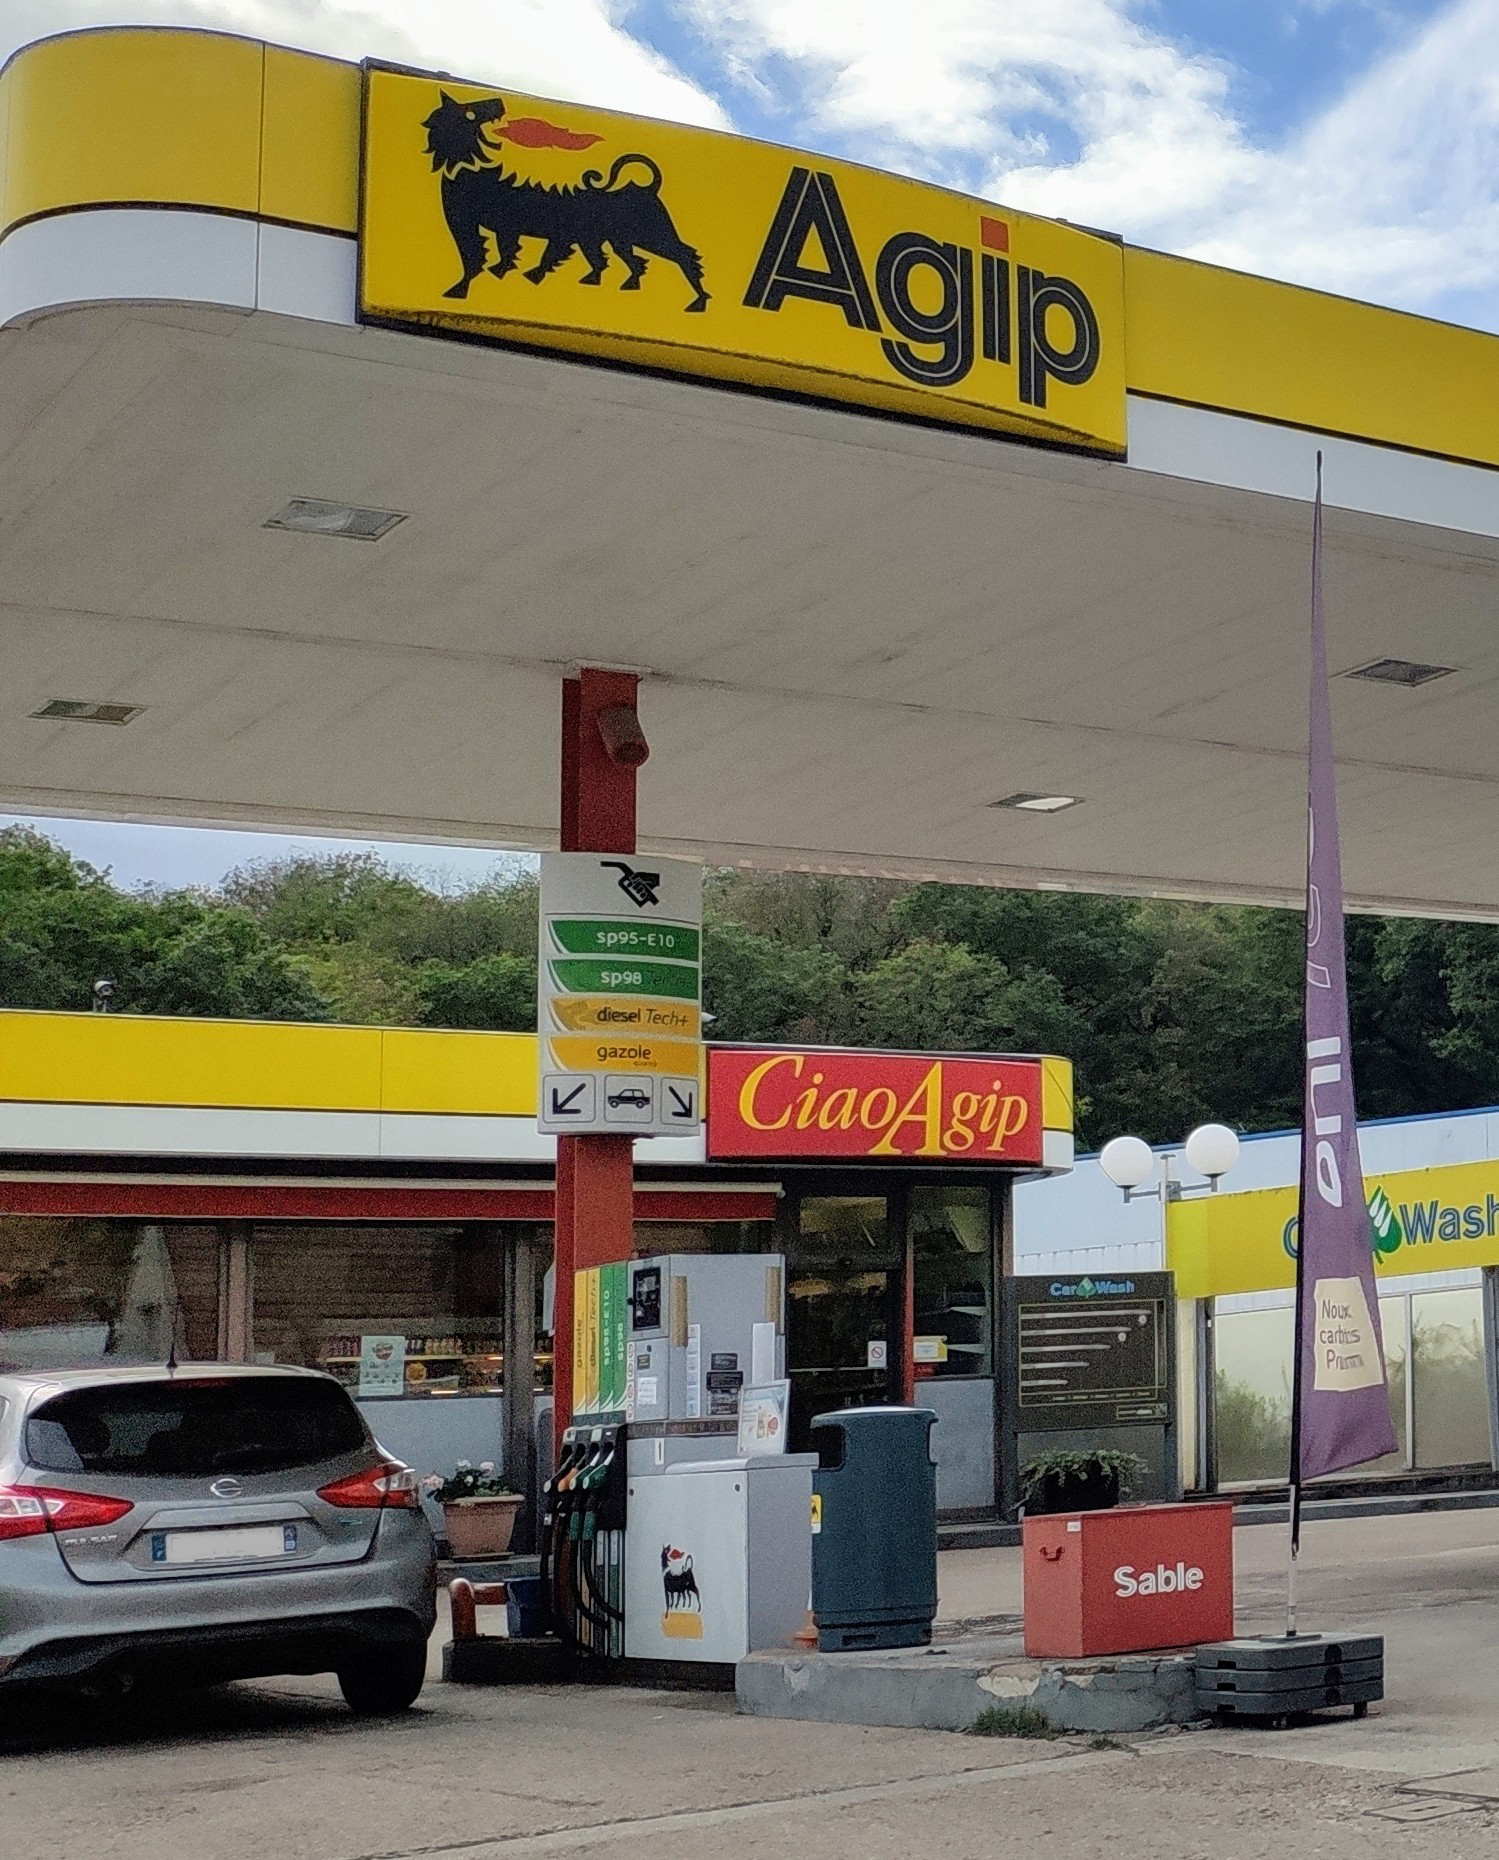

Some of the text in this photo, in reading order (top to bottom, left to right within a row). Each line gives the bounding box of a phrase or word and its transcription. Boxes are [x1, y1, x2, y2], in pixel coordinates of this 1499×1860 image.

[742, 166, 1100, 408] Agip
[596, 931, 675, 948] sp95-E10
[600, 971, 642, 987] sp98
[597, 1006, 689, 1027] diesel Tech+
[596, 1044, 651, 1062] gazole
[1050, 1281, 1135, 1296] Car Wash
[1113, 1562, 1204, 1598] Sable
